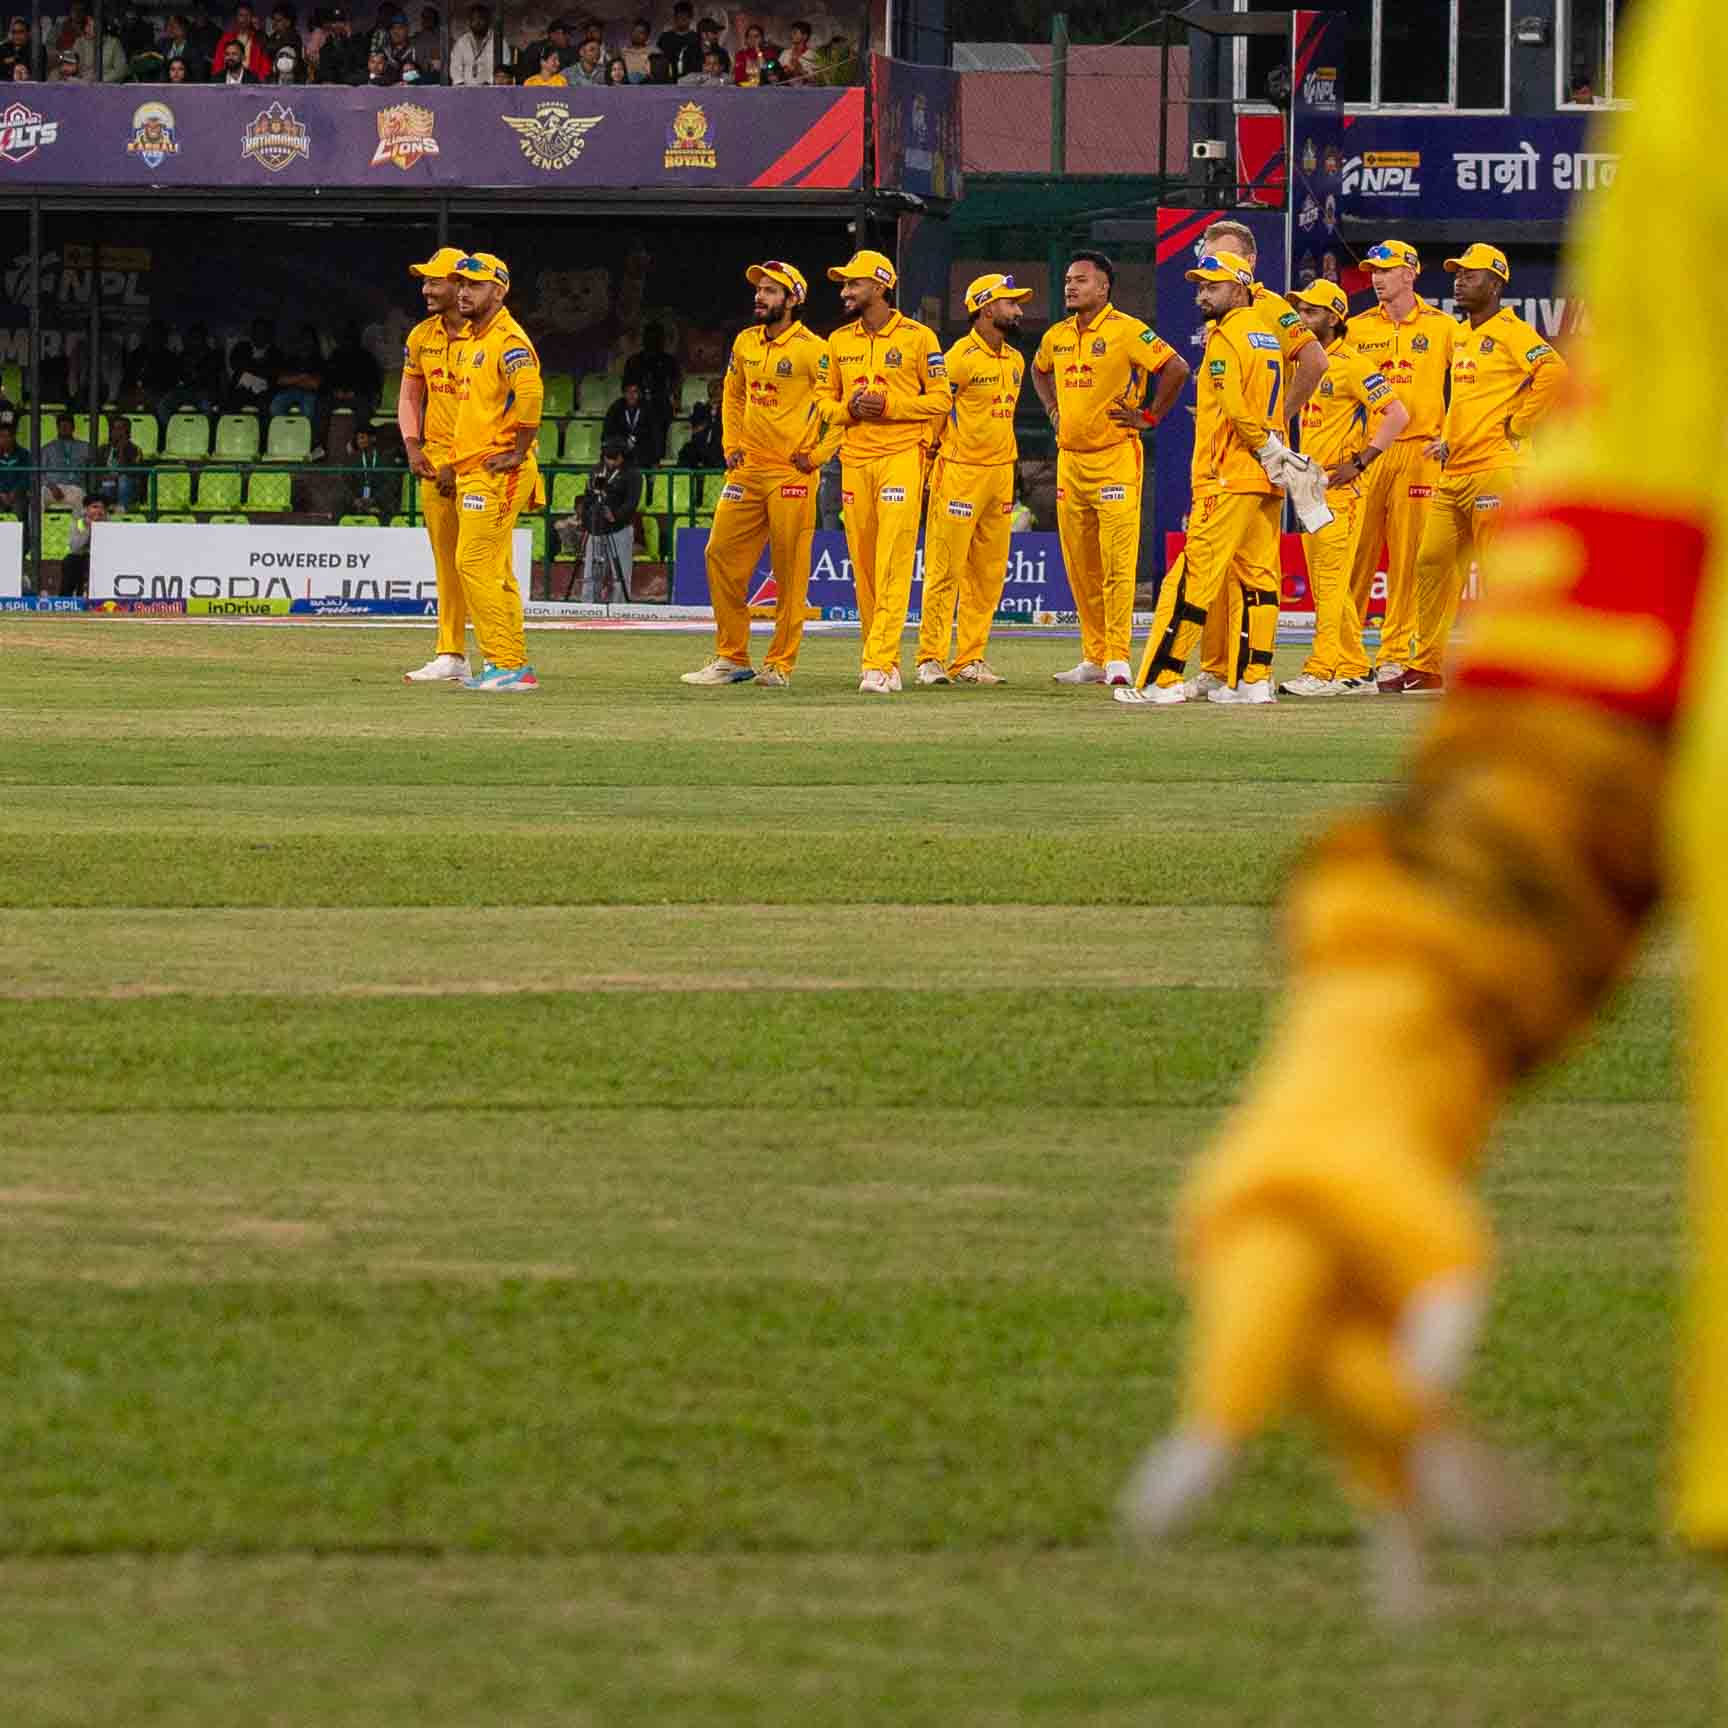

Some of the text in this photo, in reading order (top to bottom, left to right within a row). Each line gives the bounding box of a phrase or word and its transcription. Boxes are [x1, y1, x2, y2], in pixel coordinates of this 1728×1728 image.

[372, 137, 441, 164] LIONS
[518, 135, 586, 171] AVENGERS
[664, 154, 718, 169] ROYALS
[1451, 140, 1541, 195] हाम्रो
[1360, 168, 1421, 192] NPL
[1357, 340, 1390, 351] Marvel
[1267, 360, 1281, 417] 7
[249, 552, 371, 570] POWERED BY
[114, 574, 438, 600] OMODA JAEC
[5, 597, 30, 611] SPIL
[54, 599, 81, 612] SPIL
[208, 601, 272, 616] inDrive
